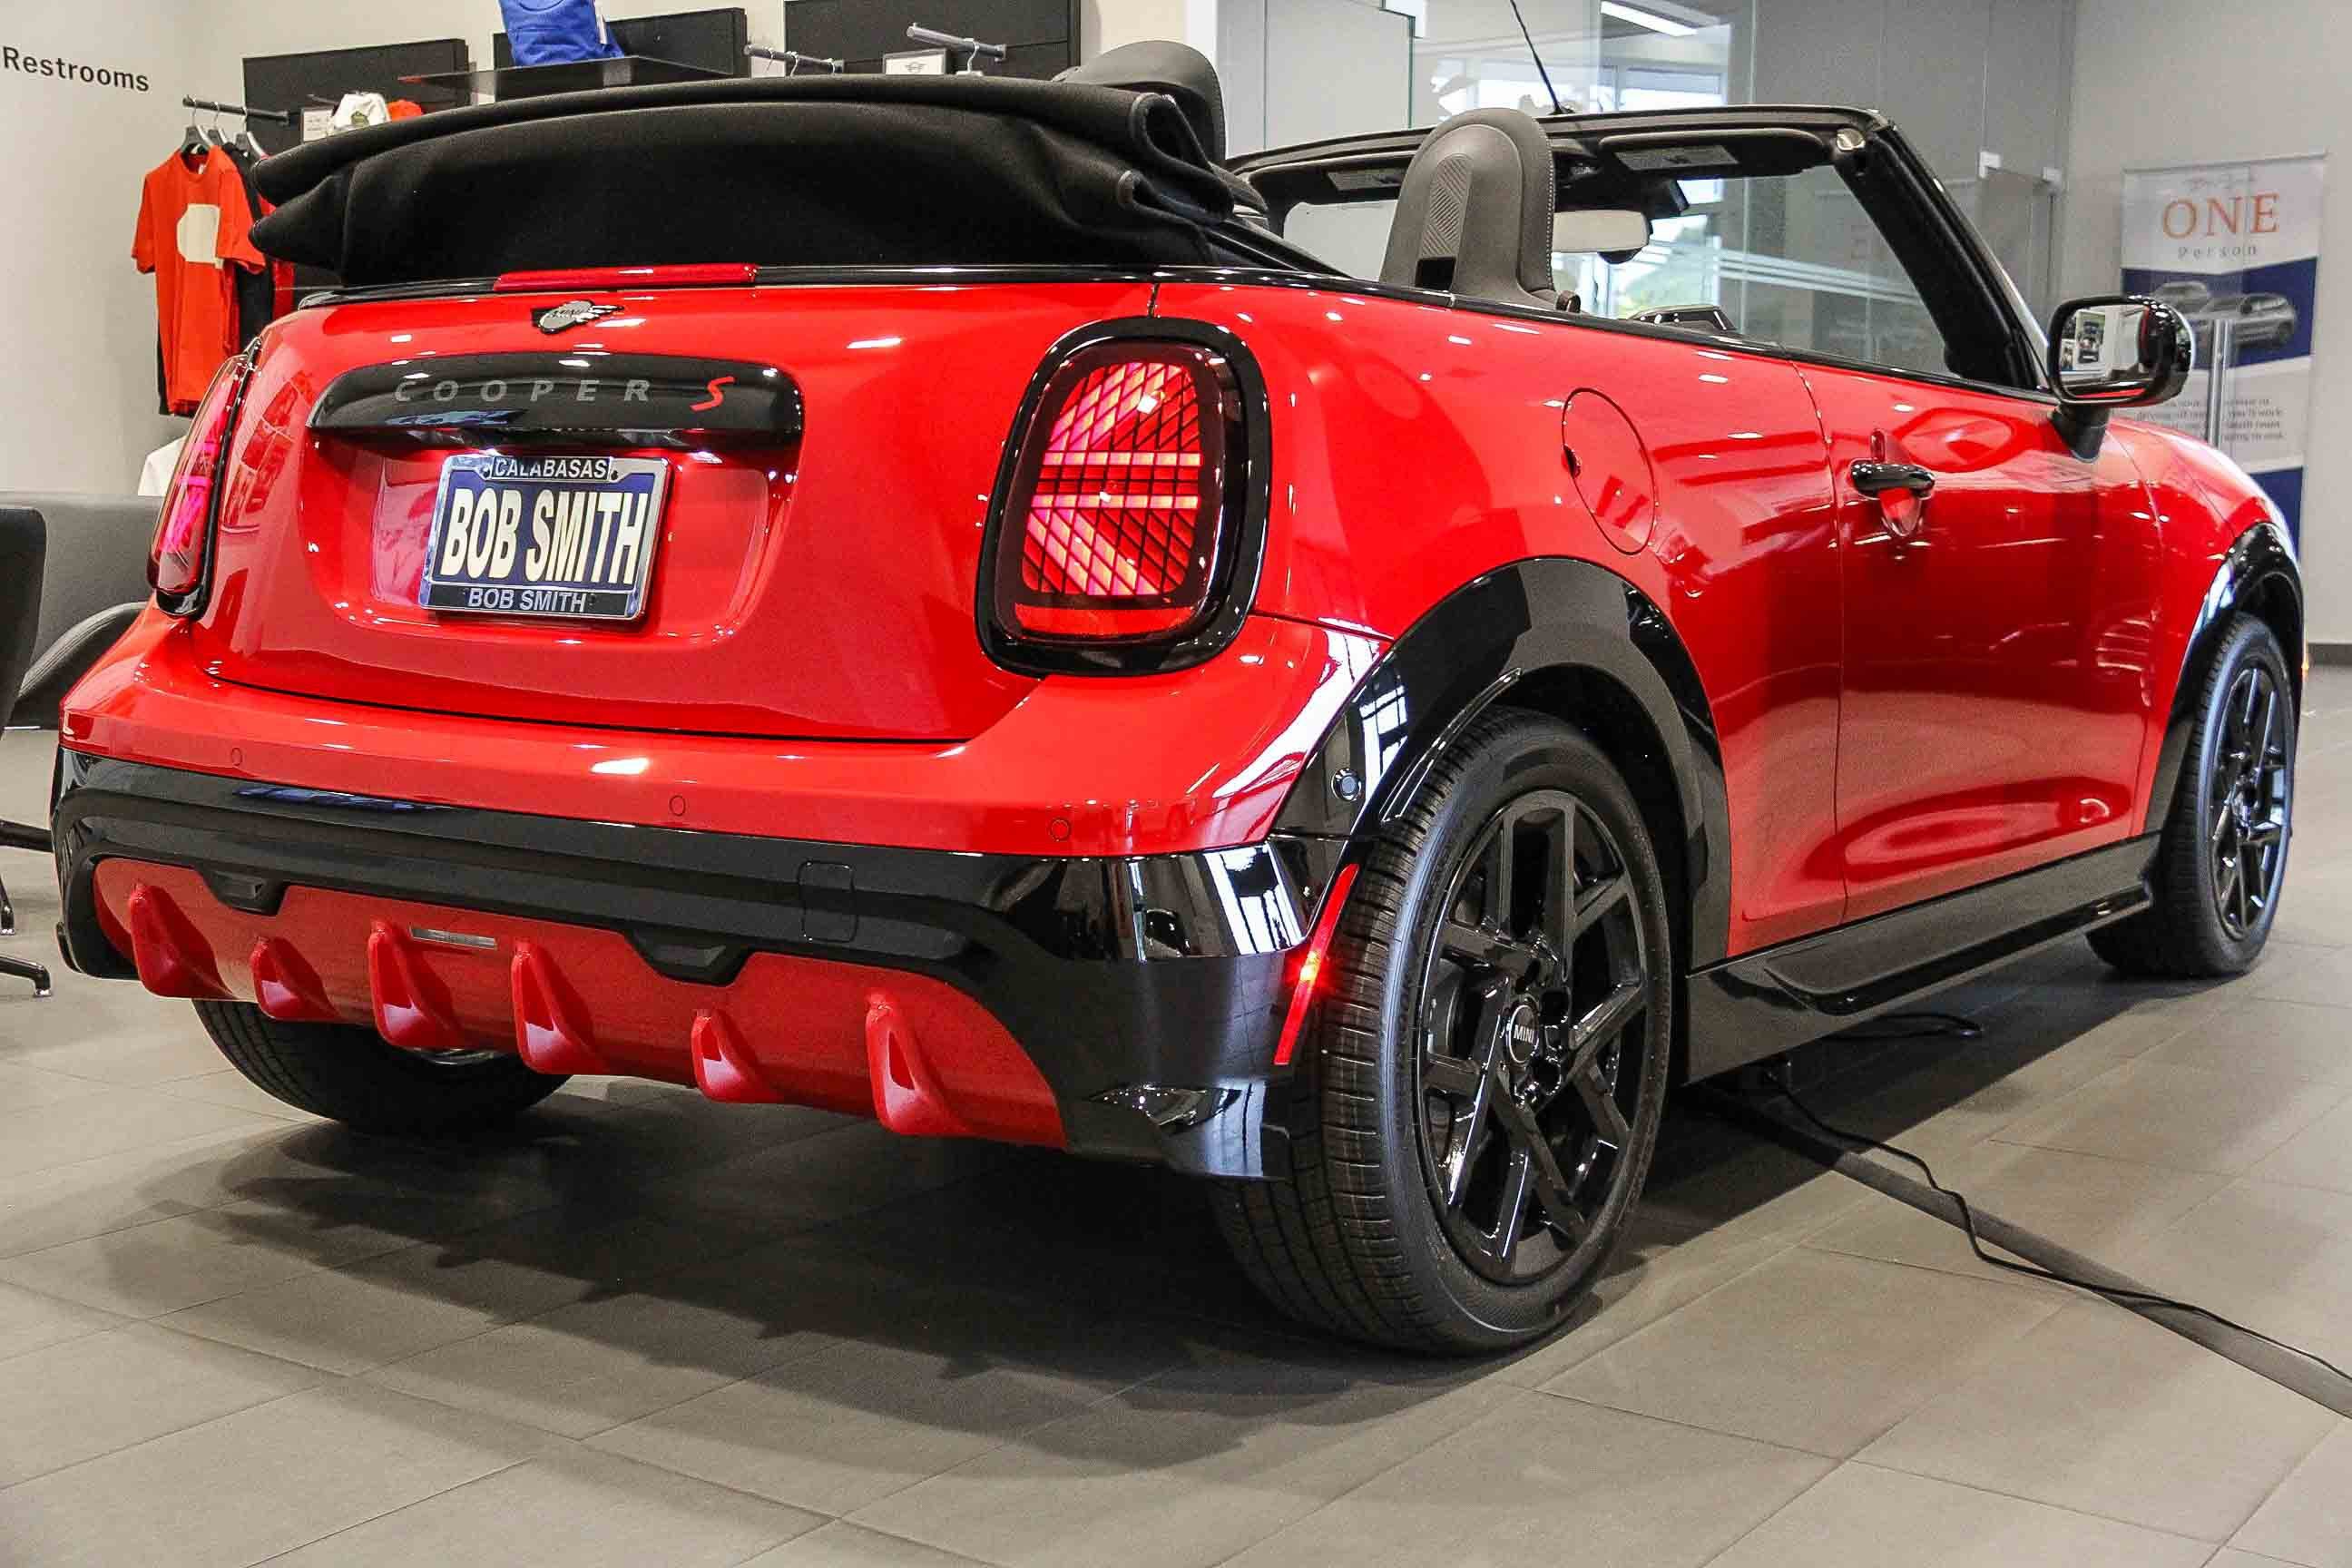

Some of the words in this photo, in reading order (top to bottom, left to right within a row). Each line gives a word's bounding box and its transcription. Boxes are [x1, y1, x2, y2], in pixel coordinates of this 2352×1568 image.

[3, 46, 150, 92] Restrooms
[2163, 192, 2279, 240] ONE
[394, 379, 650, 402] COOPER
[690, 376, 735, 412] S
[494, 458, 608, 478] CALABASAS
[439, 488, 523, 579] BOB
[525, 489, 649, 585] SMITH
[468, 588, 514, 609] BOB
[519, 590, 587, 612] SMITH
[1514, 1024, 1534, 1044] MINI
